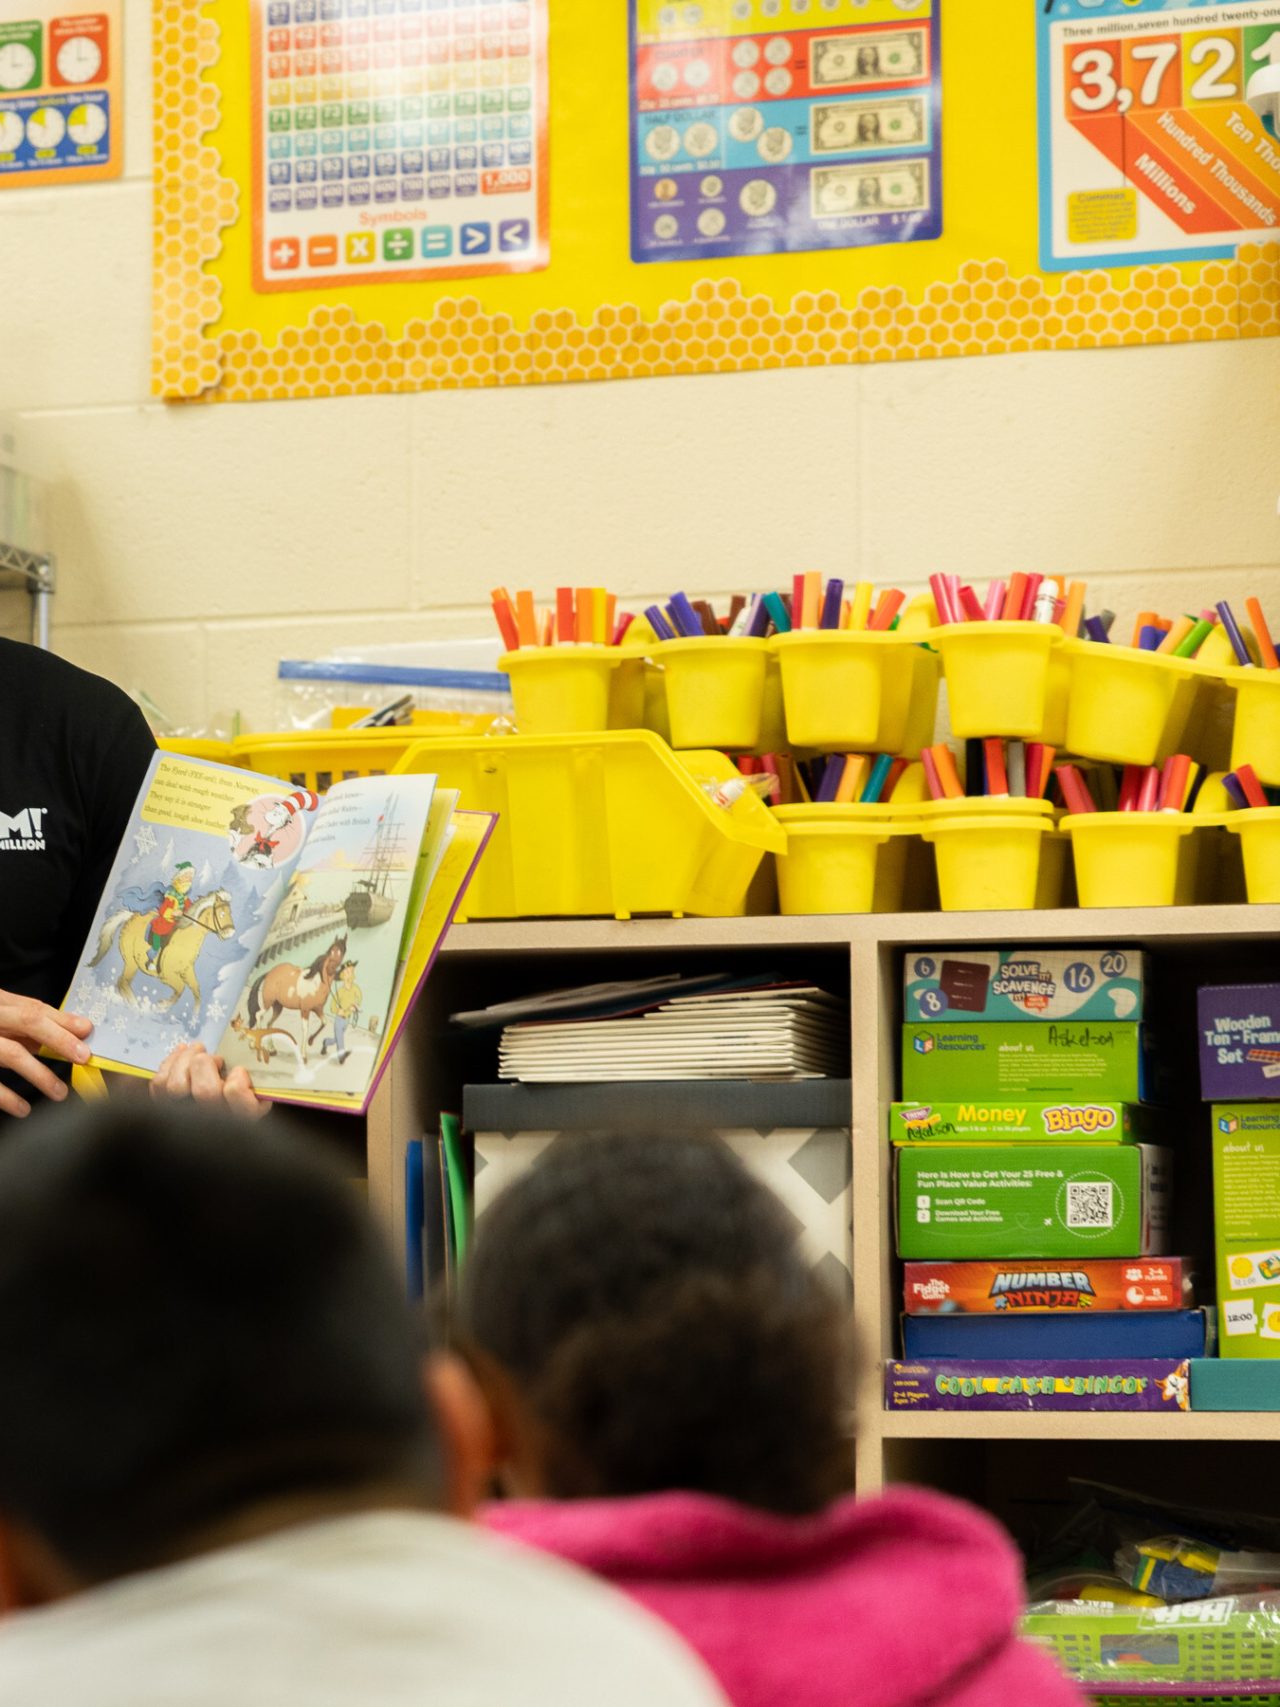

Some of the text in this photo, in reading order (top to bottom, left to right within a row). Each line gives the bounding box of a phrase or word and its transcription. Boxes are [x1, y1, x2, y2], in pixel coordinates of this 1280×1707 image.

[1063, 26, 1093, 38] Three
[1173, 13, 1218, 26] hundred
[1225, 110, 1254, 144] Ten
[1158, 111, 1210, 165] Hundred
[1210, 157, 1278, 226] Thousands
[1135, 153, 1196, 215] Millions
[359, 207, 428, 226] Symbols
[921, 960, 930, 976] 6
[1000, 963, 1039, 980] SOLVE
[1101, 953, 1126, 974] 20
[1068, 966, 1092, 989] 16
[992, 979, 1057, 997] SCAVENGE
[925, 990, 942, 1013] 8
[1213, 1014, 1272, 1033] Wooden
[936, 1032, 979, 1044] Learning
[936, 1042, 985, 1052] Resources
[998, 1041, 1035, 1053] about us
[1216, 1047, 1244, 1065] Set
[957, 1103, 1115, 1134] Money Bingo
[1222, 1141, 1265, 1153] about us
[917, 1171, 939, 1179] Here
[949, 1170, 970, 1179] How
[971, 1170, 982, 1178] to
[982, 1170, 999, 1179] Get
[999, 1170, 1021, 1178] Your
[1022, 1170, 1034, 1178] 25
[1035, 1169, 1055, 1178] Free
[917, 1179, 1033, 1188] Fun Place Value Activities:
[935, 1198, 954, 1206] Scan
[954, 1198, 966, 1206] QR
[966, 1198, 986, 1206] Code
[935, 1209, 968, 1217] Download
[968, 1209, 984, 1217] Your
[970, 1215, 1003, 1223] Activities
[912, 1282, 951, 1296] Fidget
[989, 1271, 1097, 1297] NUMBER
[921, 1292, 946, 1300] Game
[1004, 1290, 1080, 1308] NINJA
[1227, 1312, 1253, 1323] 12:00
[935, 1374, 987, 1397] COOL
